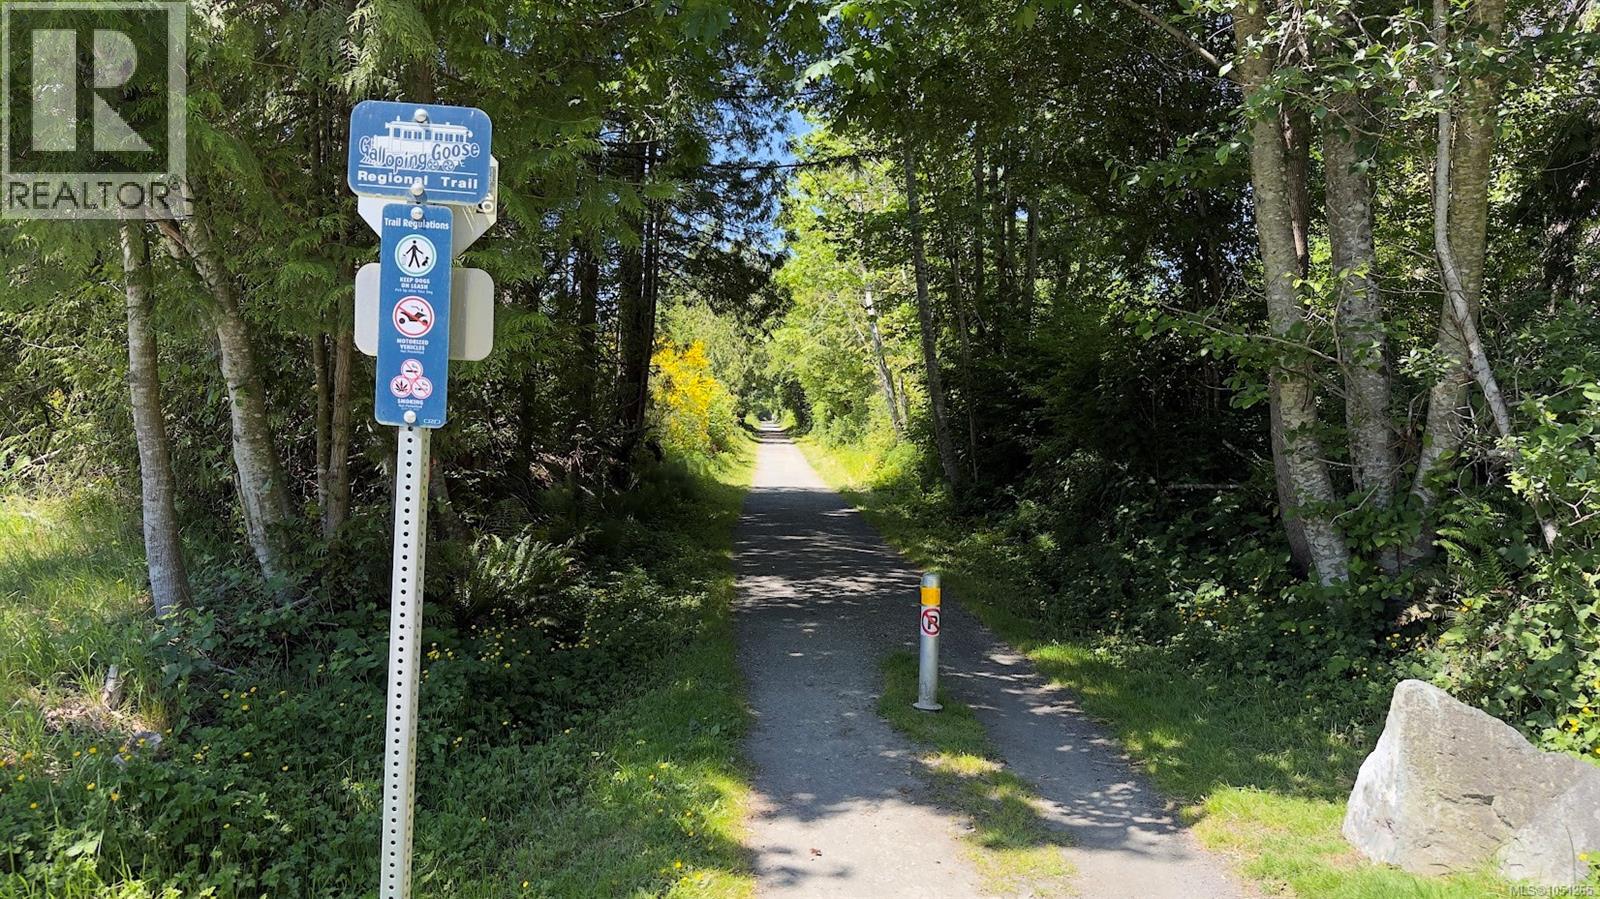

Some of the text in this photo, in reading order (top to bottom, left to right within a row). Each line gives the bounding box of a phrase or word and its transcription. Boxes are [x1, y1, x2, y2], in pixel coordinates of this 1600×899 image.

[359, 136, 481, 173] Galloping Goose
[357, 170, 478, 189] Regional Trail
[384, 217, 450, 230] Trail Regulations
